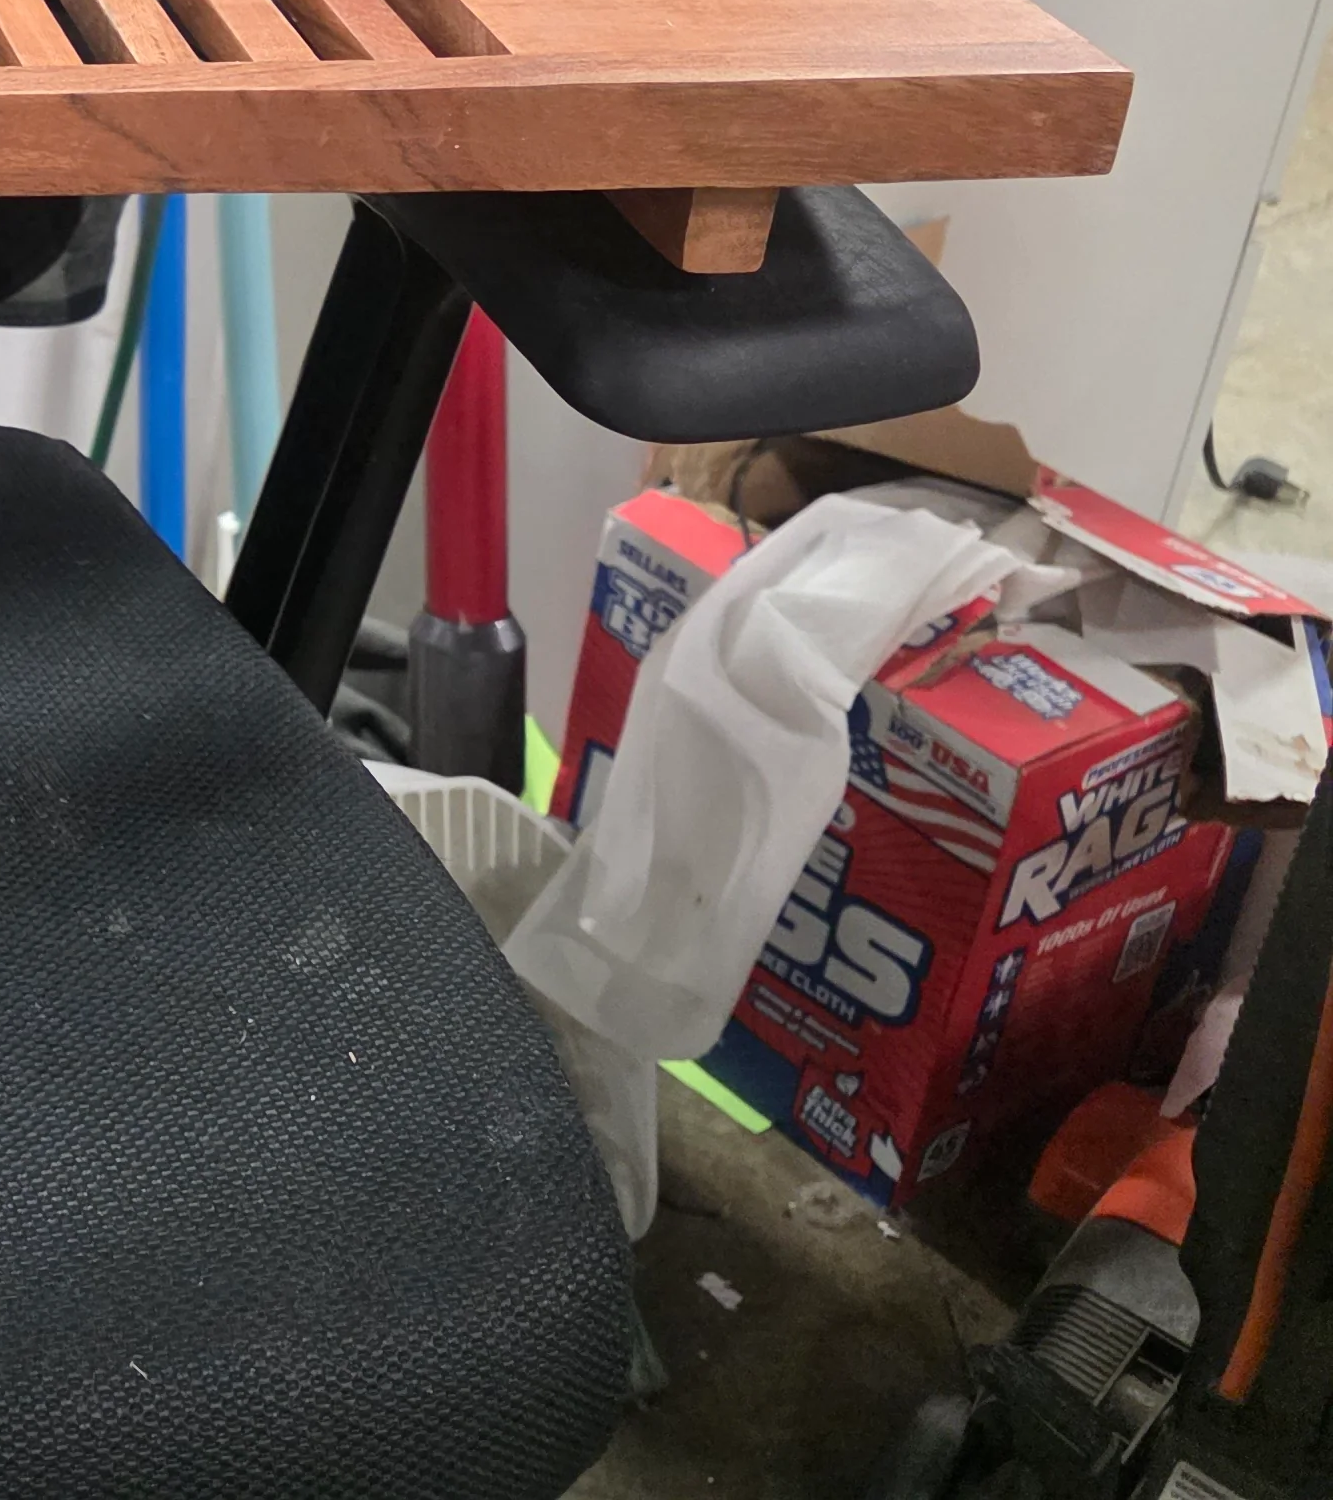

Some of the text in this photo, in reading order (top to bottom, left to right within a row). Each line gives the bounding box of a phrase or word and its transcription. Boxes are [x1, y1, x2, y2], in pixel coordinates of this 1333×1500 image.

[618, 539, 688, 595] SELLARS
[932, 740, 990, 796] USA
[998, 778, 1187, 928] RAG
[1142, 829, 1183, 863] CLOTH
[790, 967, 857, 1023] CLOTH
